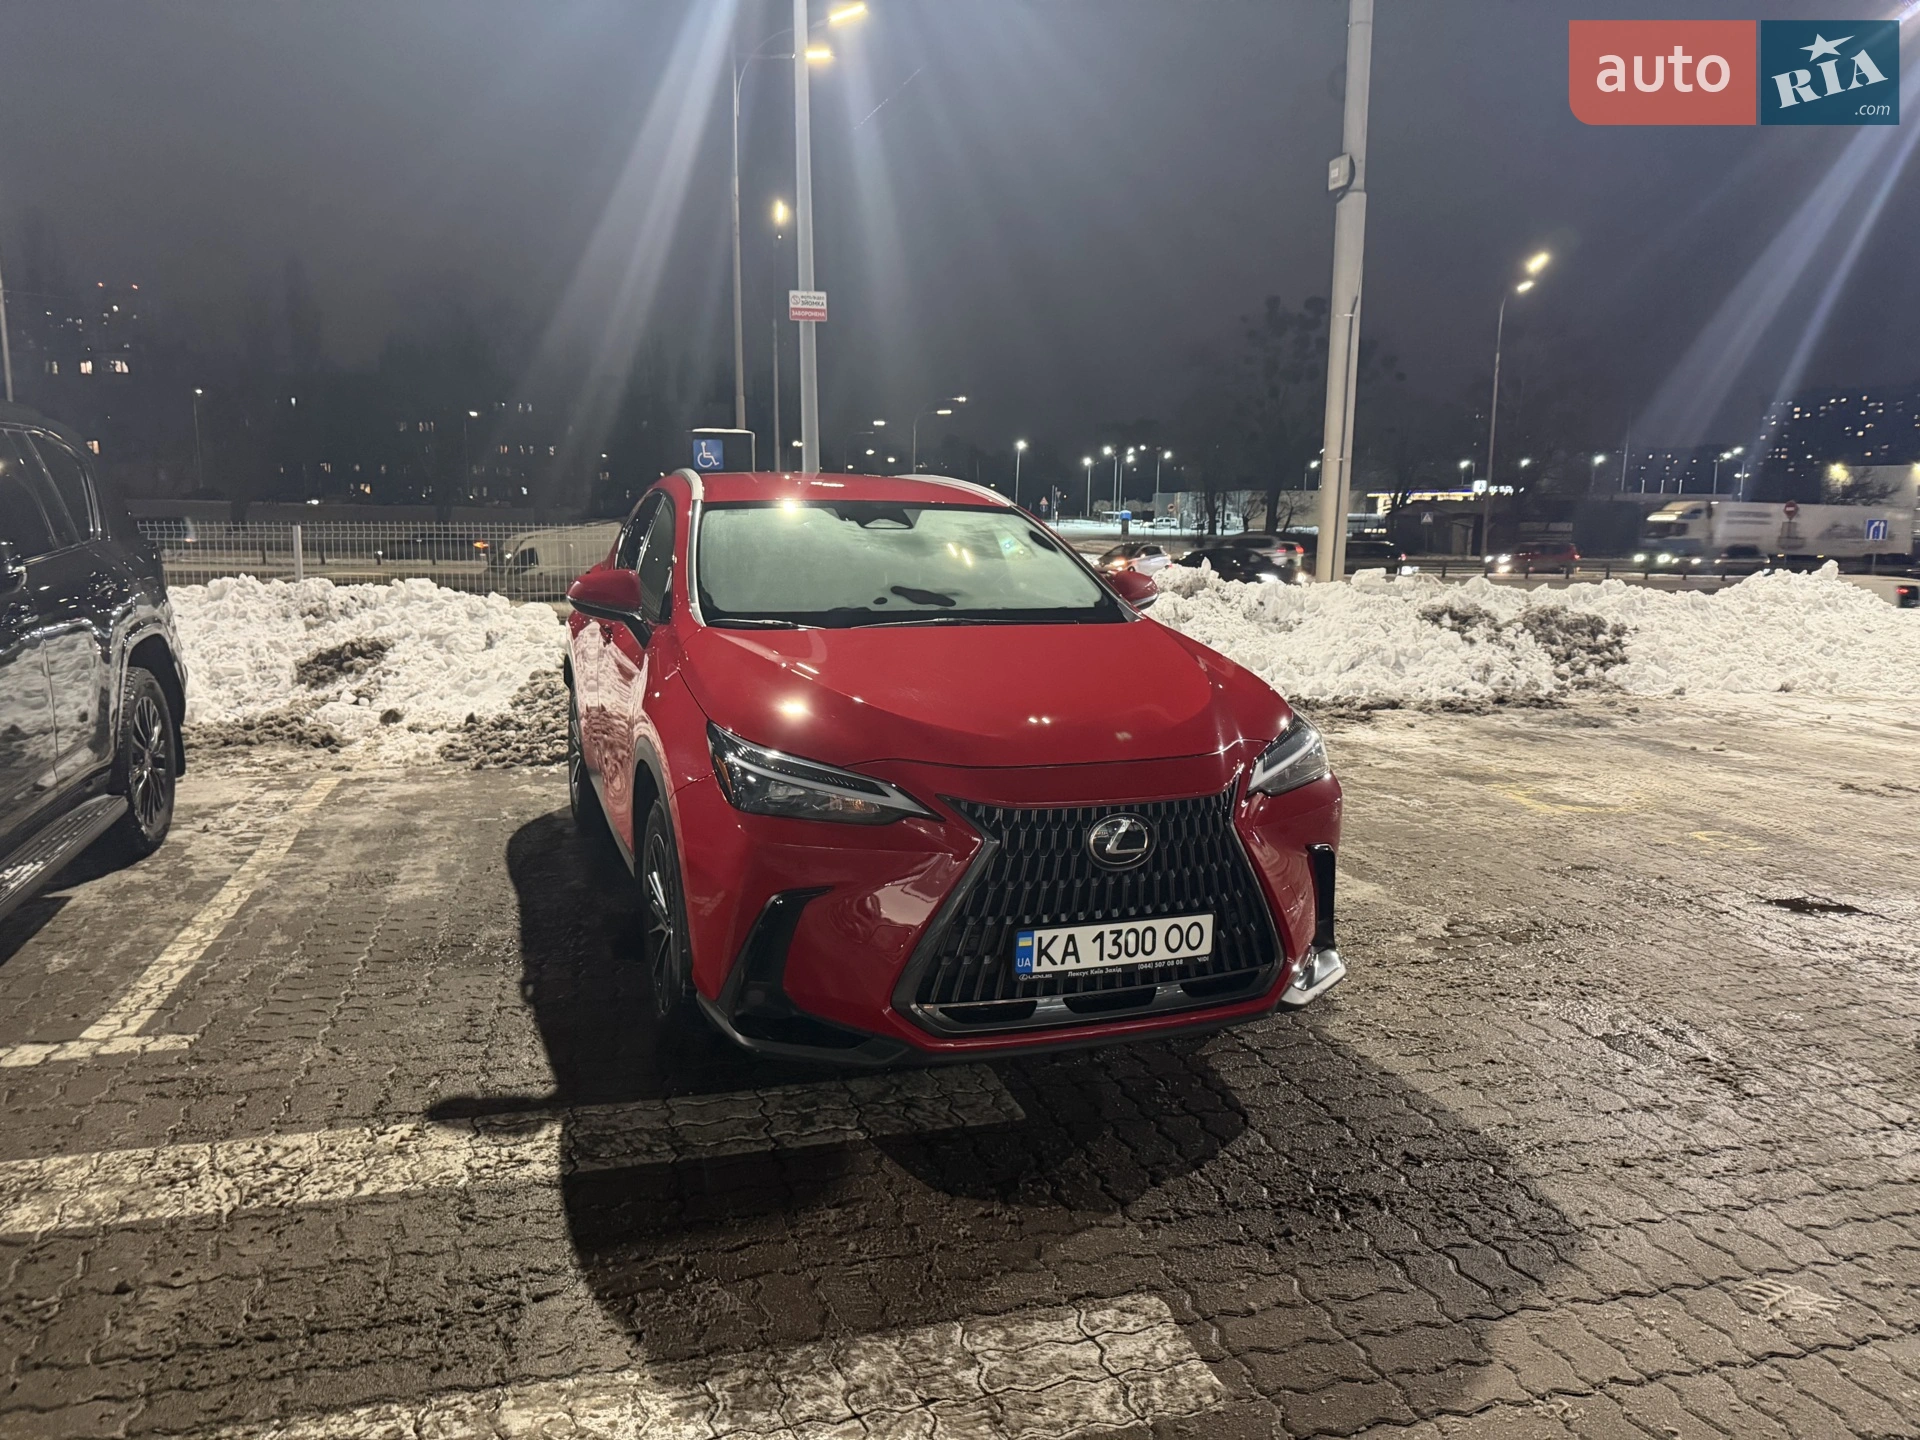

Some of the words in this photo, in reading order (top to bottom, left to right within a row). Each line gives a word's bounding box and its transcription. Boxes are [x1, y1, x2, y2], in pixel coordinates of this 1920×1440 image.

[1036, 933, 1081, 967] KA
[1092, 927, 1157, 961] 1300
[1164, 921, 1204, 954] OO
[1017, 957, 1031, 968] UA
